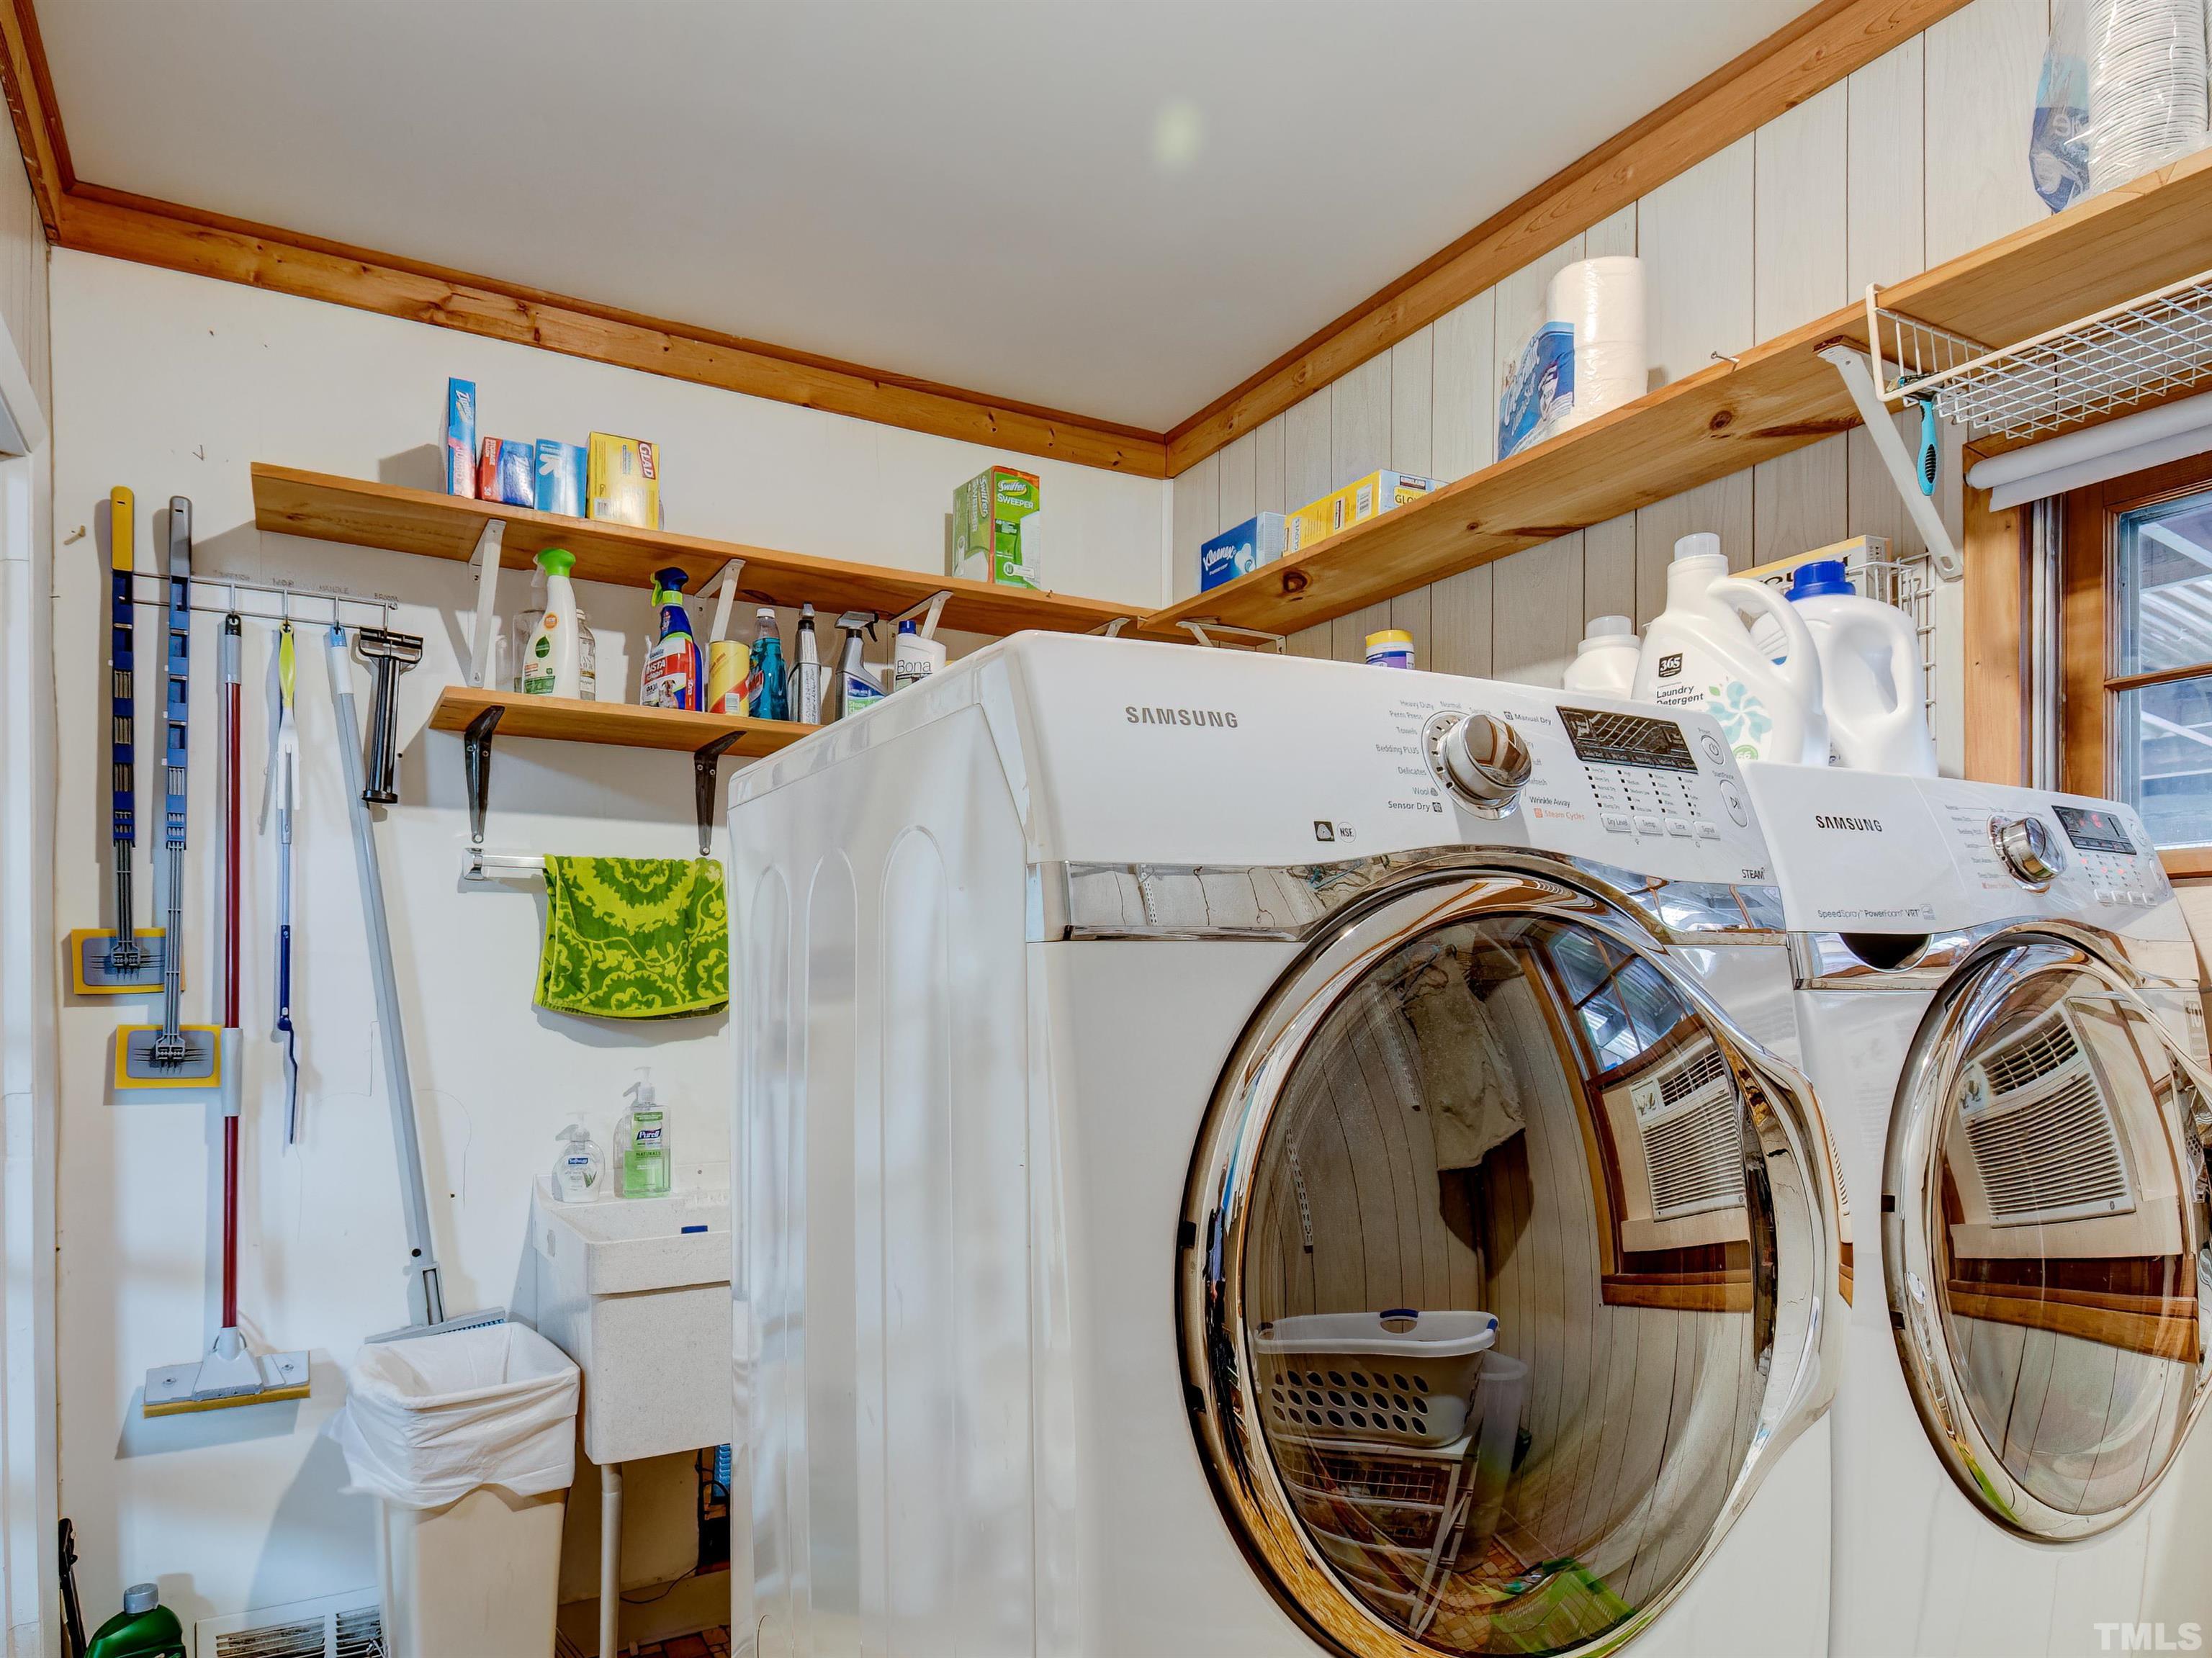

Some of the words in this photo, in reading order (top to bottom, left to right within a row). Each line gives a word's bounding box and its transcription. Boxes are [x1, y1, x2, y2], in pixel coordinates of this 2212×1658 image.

[639, 442, 655, 478] GLAD
[997, 479, 1027, 492] Swiffer
[978, 475, 989, 518] Swiffer
[997, 494, 1034, 510] SWEEPER
[1203, 546, 1236, 571] Kleenex
[645, 659, 667, 675] INSTA
[896, 659, 932, 675] Bona
[1660, 657, 1681, 672] 365
[1656, 685, 1694, 698] Laundry
[1125, 706, 1238, 729] SAMSUNG
[1514, 713, 1539, 724] Manual
[1539, 716, 1552, 726] Dry
[1395, 726, 1418, 735] Towels
[1376, 744, 1402, 754] Bedding
[1403, 746, 1419, 754] PLUS
[1398, 767, 1427, 776] Delicates
[1412, 787, 1429, 796] Wool
[1388, 801, 1416, 811] Sensor
[1416, 802, 1431, 812] Dry
[1529, 796, 1553, 806] Wrinkle
[1544, 810, 1563, 819] Steam
[1563, 811, 1586, 821] Cycles
[1606, 817, 1617, 827] Dry
[1815, 814, 1883, 834] SAMSUNG
[1741, 869, 1765, 880] STEAM
[638, 1130, 660, 1139] Purell
